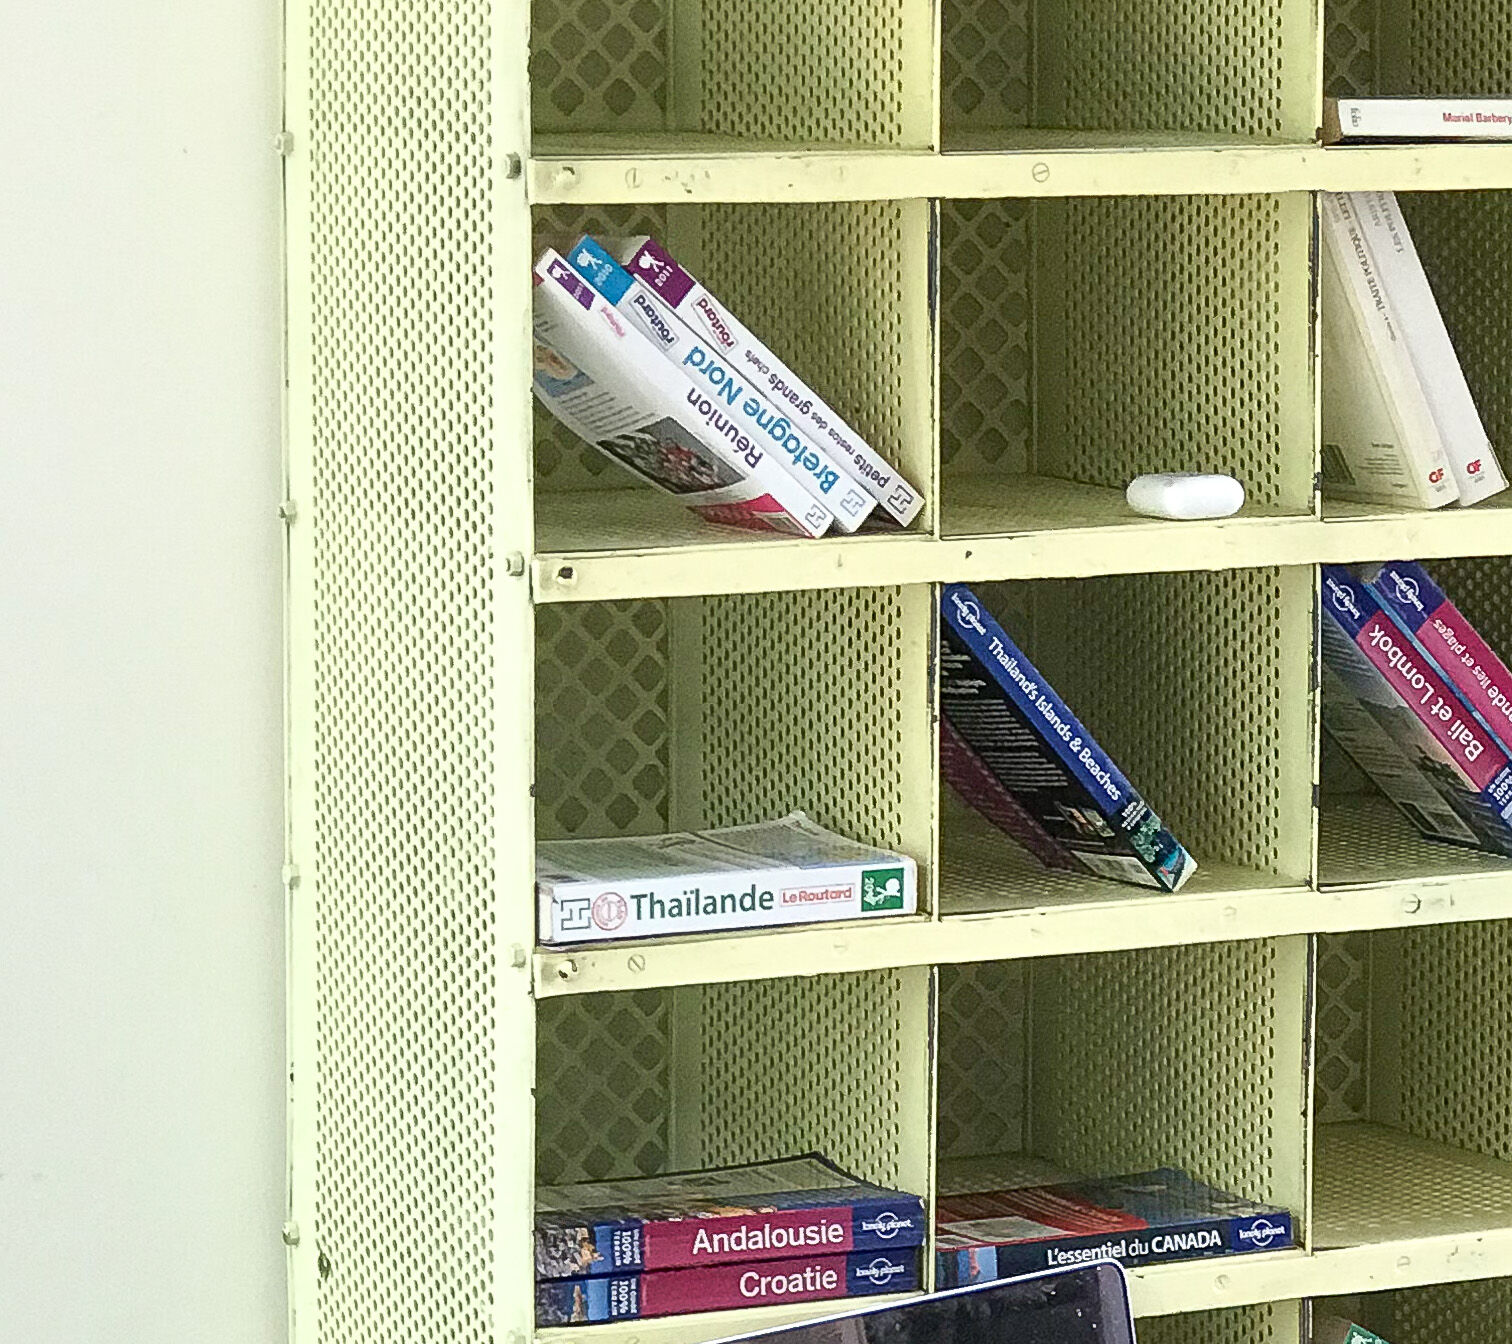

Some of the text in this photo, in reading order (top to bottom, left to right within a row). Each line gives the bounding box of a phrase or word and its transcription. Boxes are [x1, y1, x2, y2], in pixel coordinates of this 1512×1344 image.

[633, 293, 675, 345] routard
[696, 296, 736, 349] routard
[682, 345, 745, 407] Nord
[768, 372, 814, 416] grands
[686, 387, 764, 469] Réunion
[742, 398, 841, 494] Bretagne
[852, 451, 891, 489] petits
[1434, 619, 1466, 657] plages
[1463, 653, 1476, 667] et
[1368, 624, 1485, 762] Bali et Lombok
[987, 637, 1122, 801] Thailand's Islands & Beaches
[630, 884, 774, 921] Thaïlande
[622, 1231, 632, 1264] 100%
[692, 1219, 844, 1255] Andalousie
[1047, 1230, 1222, 1266] L'essentiel du CANADA
[618, 1280, 629, 1314] 100%
[739, 1266, 838, 1297] Croatie
